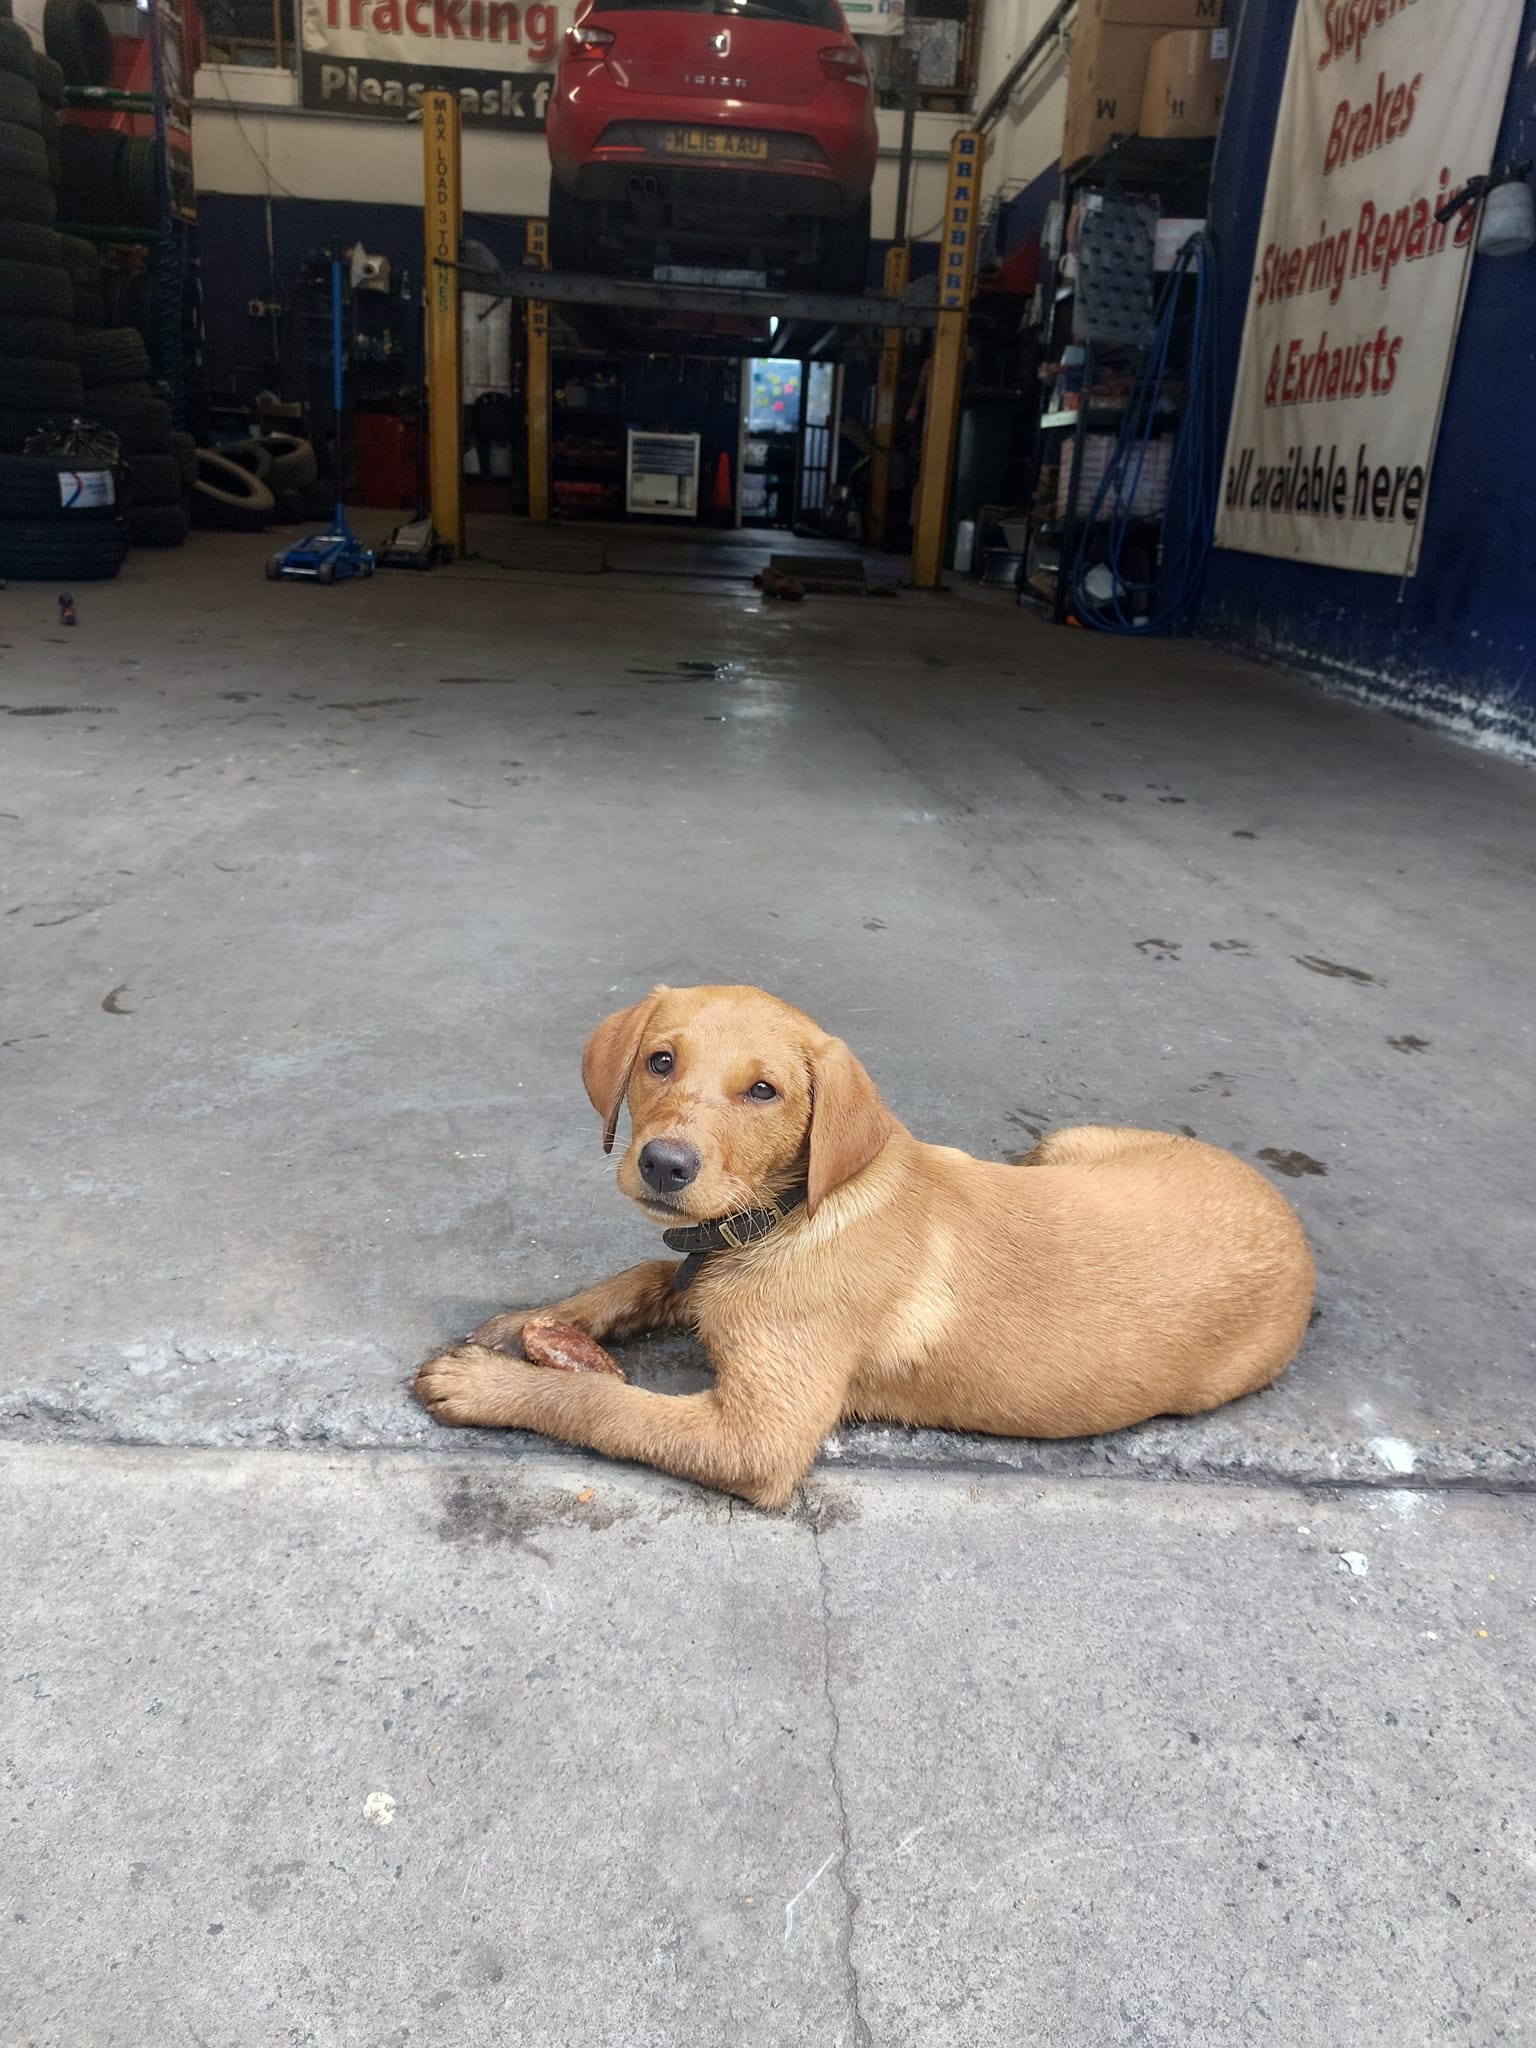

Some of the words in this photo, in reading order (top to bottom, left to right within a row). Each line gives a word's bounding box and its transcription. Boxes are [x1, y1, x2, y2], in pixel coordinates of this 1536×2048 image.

[321, 64, 446, 109] Pleas
[459, 80, 525, 117] ask
[433, 98, 446, 140] MAX
[1323, 71, 1423, 176] Brakes
[436, 149, 448, 205] LOAD
[438, 210, 447, 223] 3
[1256, 219, 1353, 306] Steering
[1264, 343, 1281, 408] &
[1282, 325, 1403, 405] Exhausts
[1226, 447, 1256, 511] all
[1250, 445, 1347, 519] available
[1352, 444, 1425, 525] here
